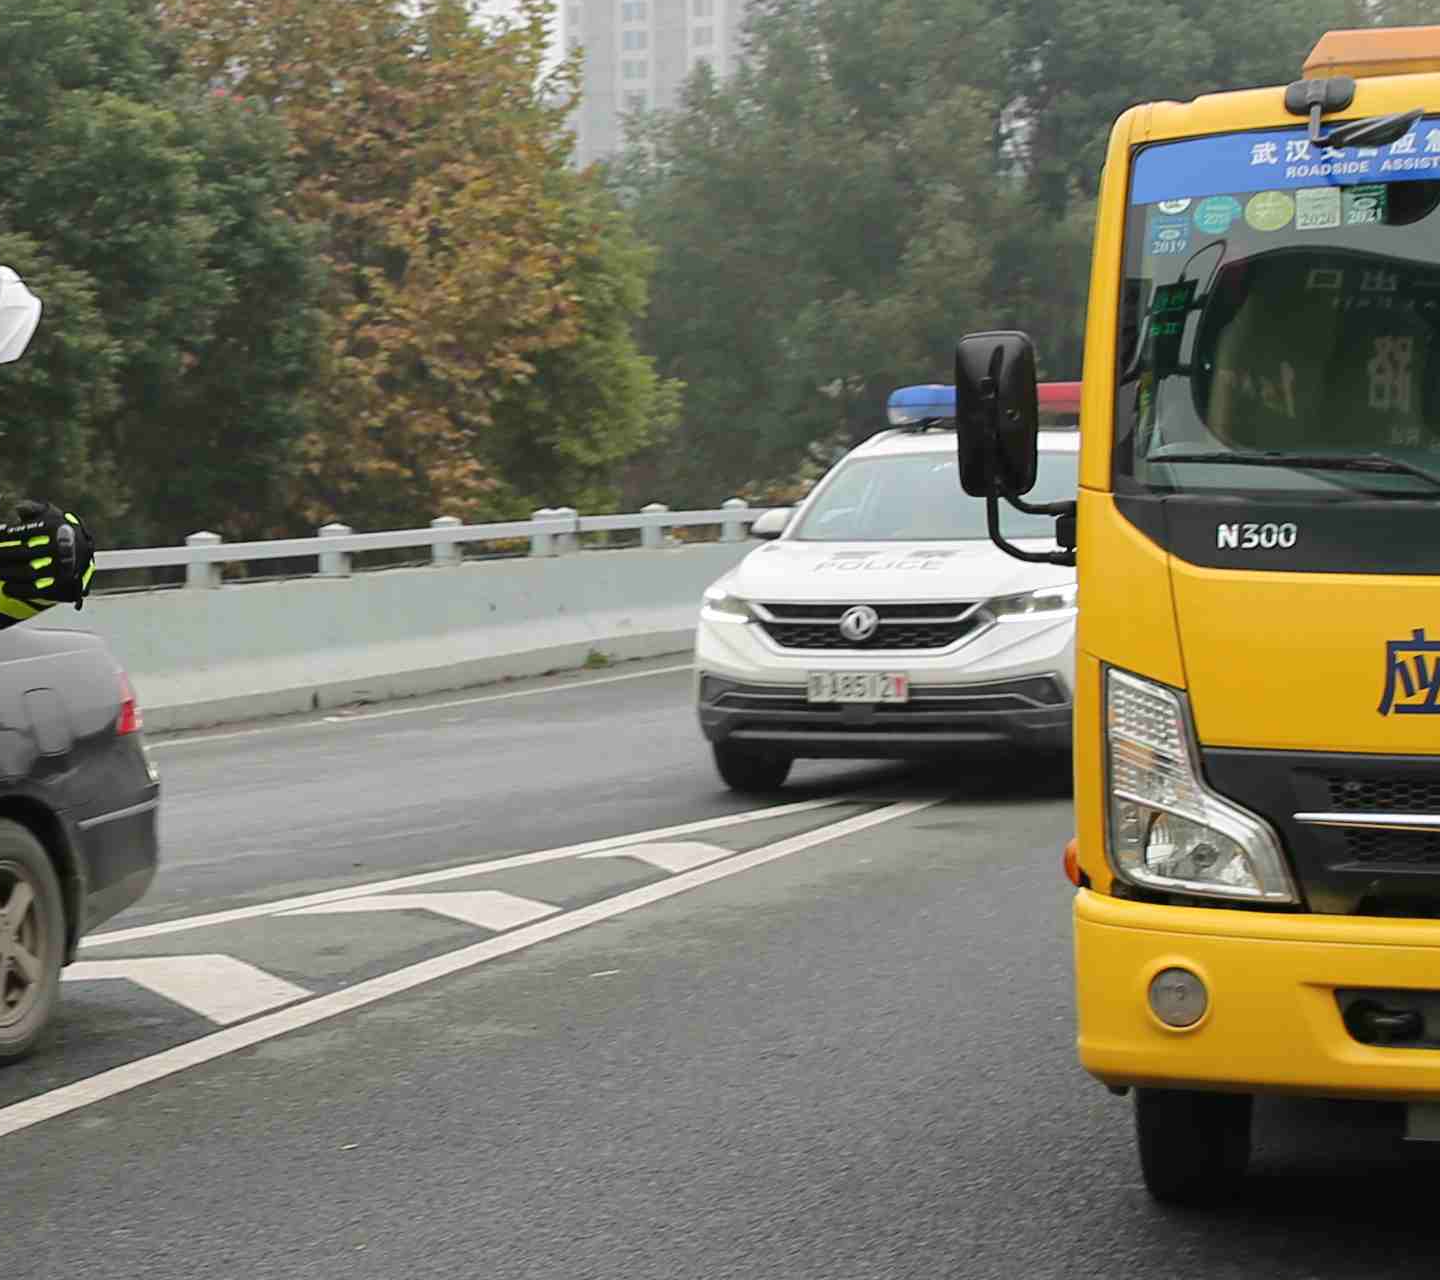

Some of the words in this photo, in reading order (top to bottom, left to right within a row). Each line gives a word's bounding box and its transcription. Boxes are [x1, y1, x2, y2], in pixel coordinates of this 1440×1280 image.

[1286, 160, 1370, 178] ROADSIDE
[1347, 208, 1383, 224] 2021
[1217, 523, 1297, 548] N300
[814, 559, 944, 572] POLICE
